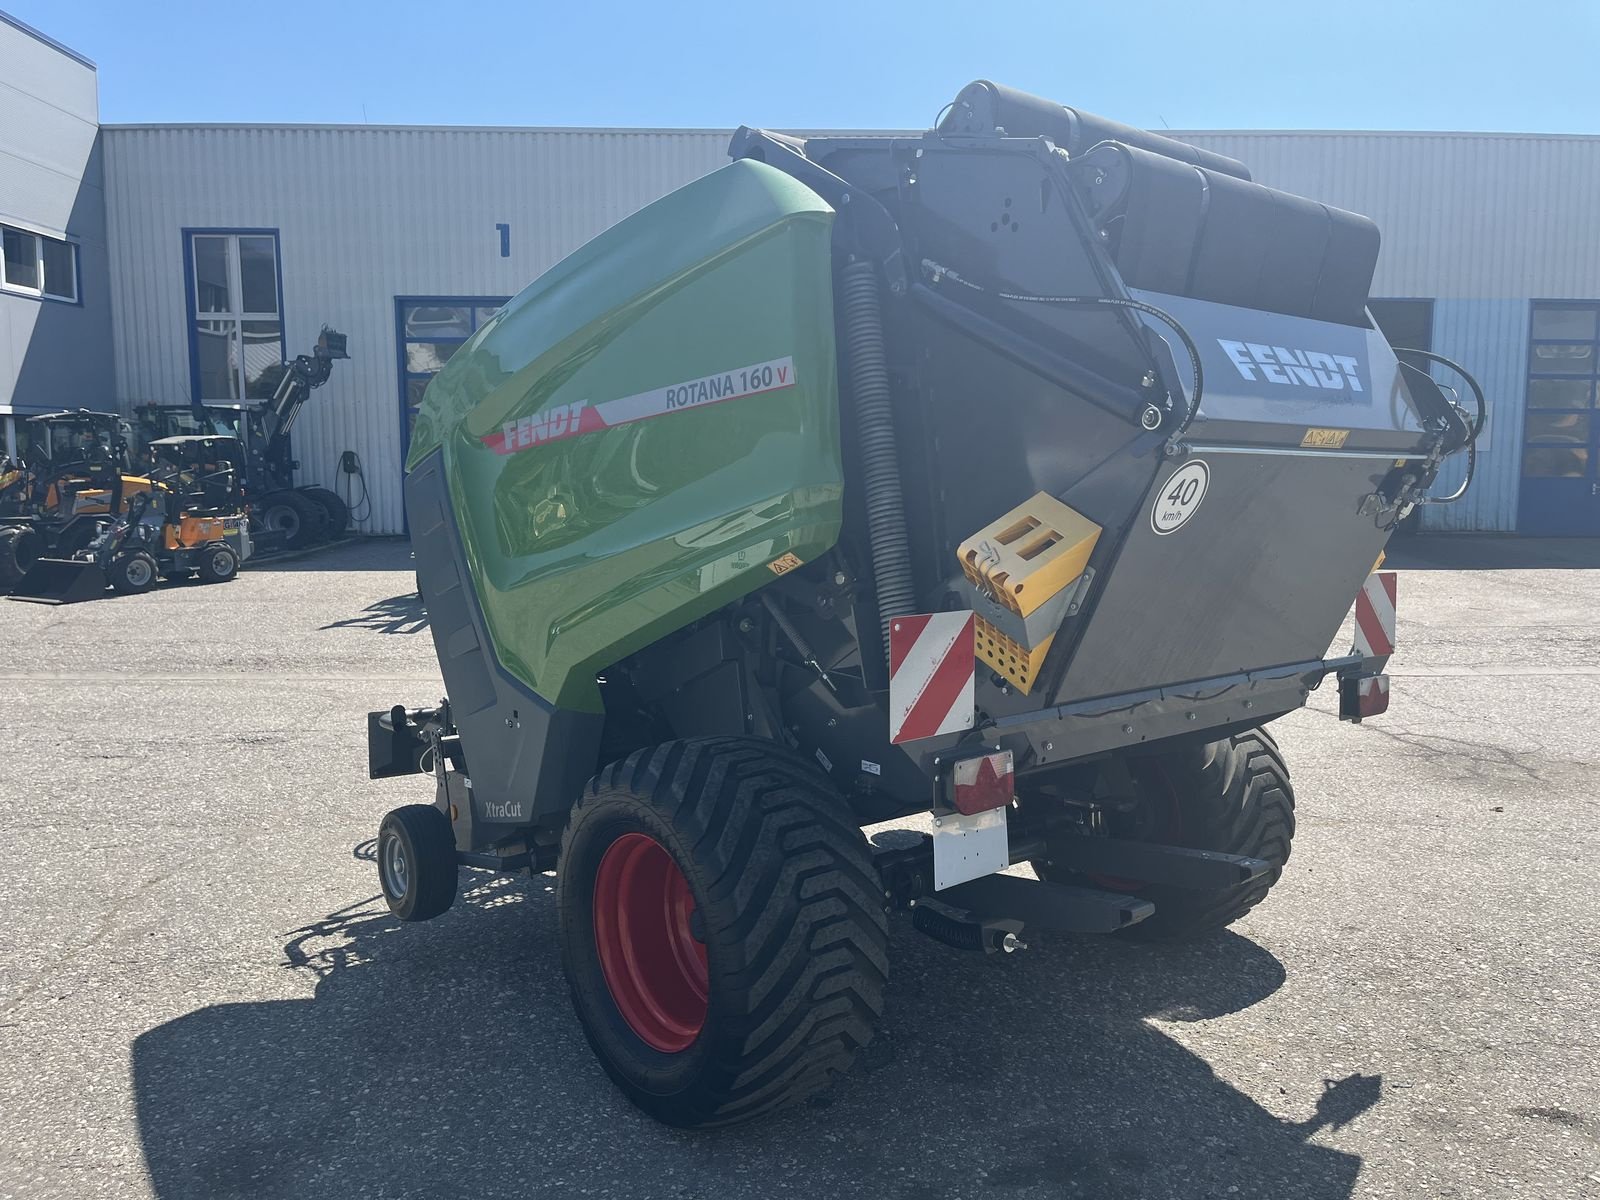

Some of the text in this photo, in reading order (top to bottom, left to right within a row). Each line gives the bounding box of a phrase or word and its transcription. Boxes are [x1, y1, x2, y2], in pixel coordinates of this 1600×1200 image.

[495, 224, 510, 257] 1
[1218, 339, 1363, 391] FENDT
[666, 366, 788, 410] ROTANA 160 V
[502, 400, 588, 450] FENDT
[1167, 478, 1199, 507] 40
[1161, 511, 1182, 522] km/h
[485, 801, 523, 818] XtraCut
